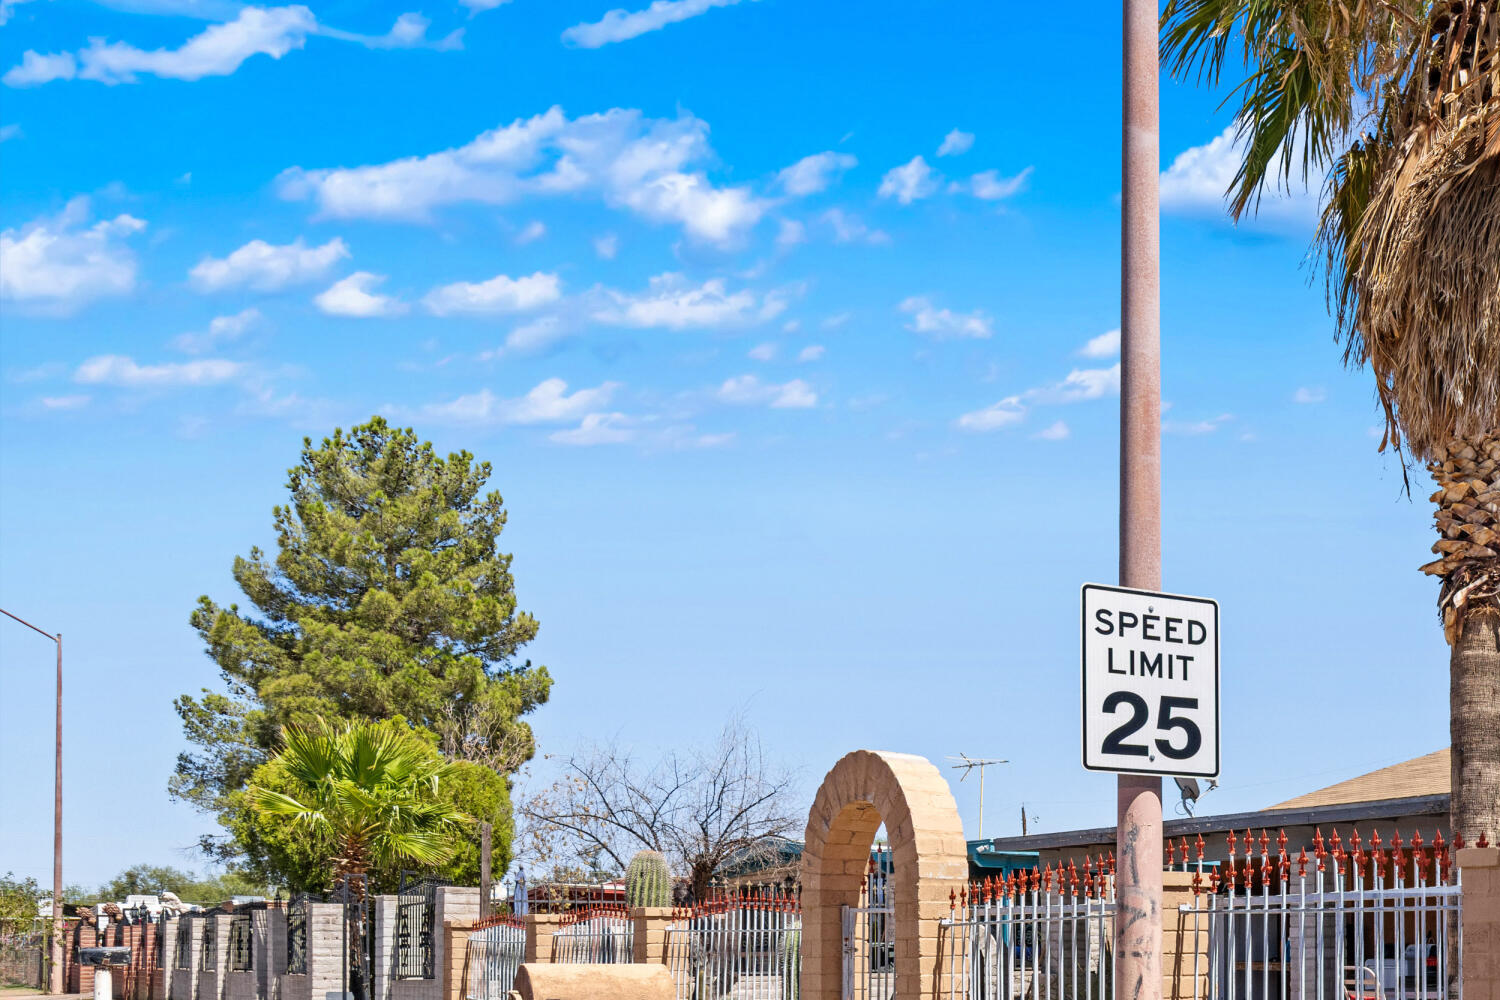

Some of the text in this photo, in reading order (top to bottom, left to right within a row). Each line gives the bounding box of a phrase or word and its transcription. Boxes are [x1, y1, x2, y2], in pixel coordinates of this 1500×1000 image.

[1095, 608, 1207, 646] SPEED
[1107, 647, 1195, 681] LIMIT
[1101, 690, 1202, 760] 25
